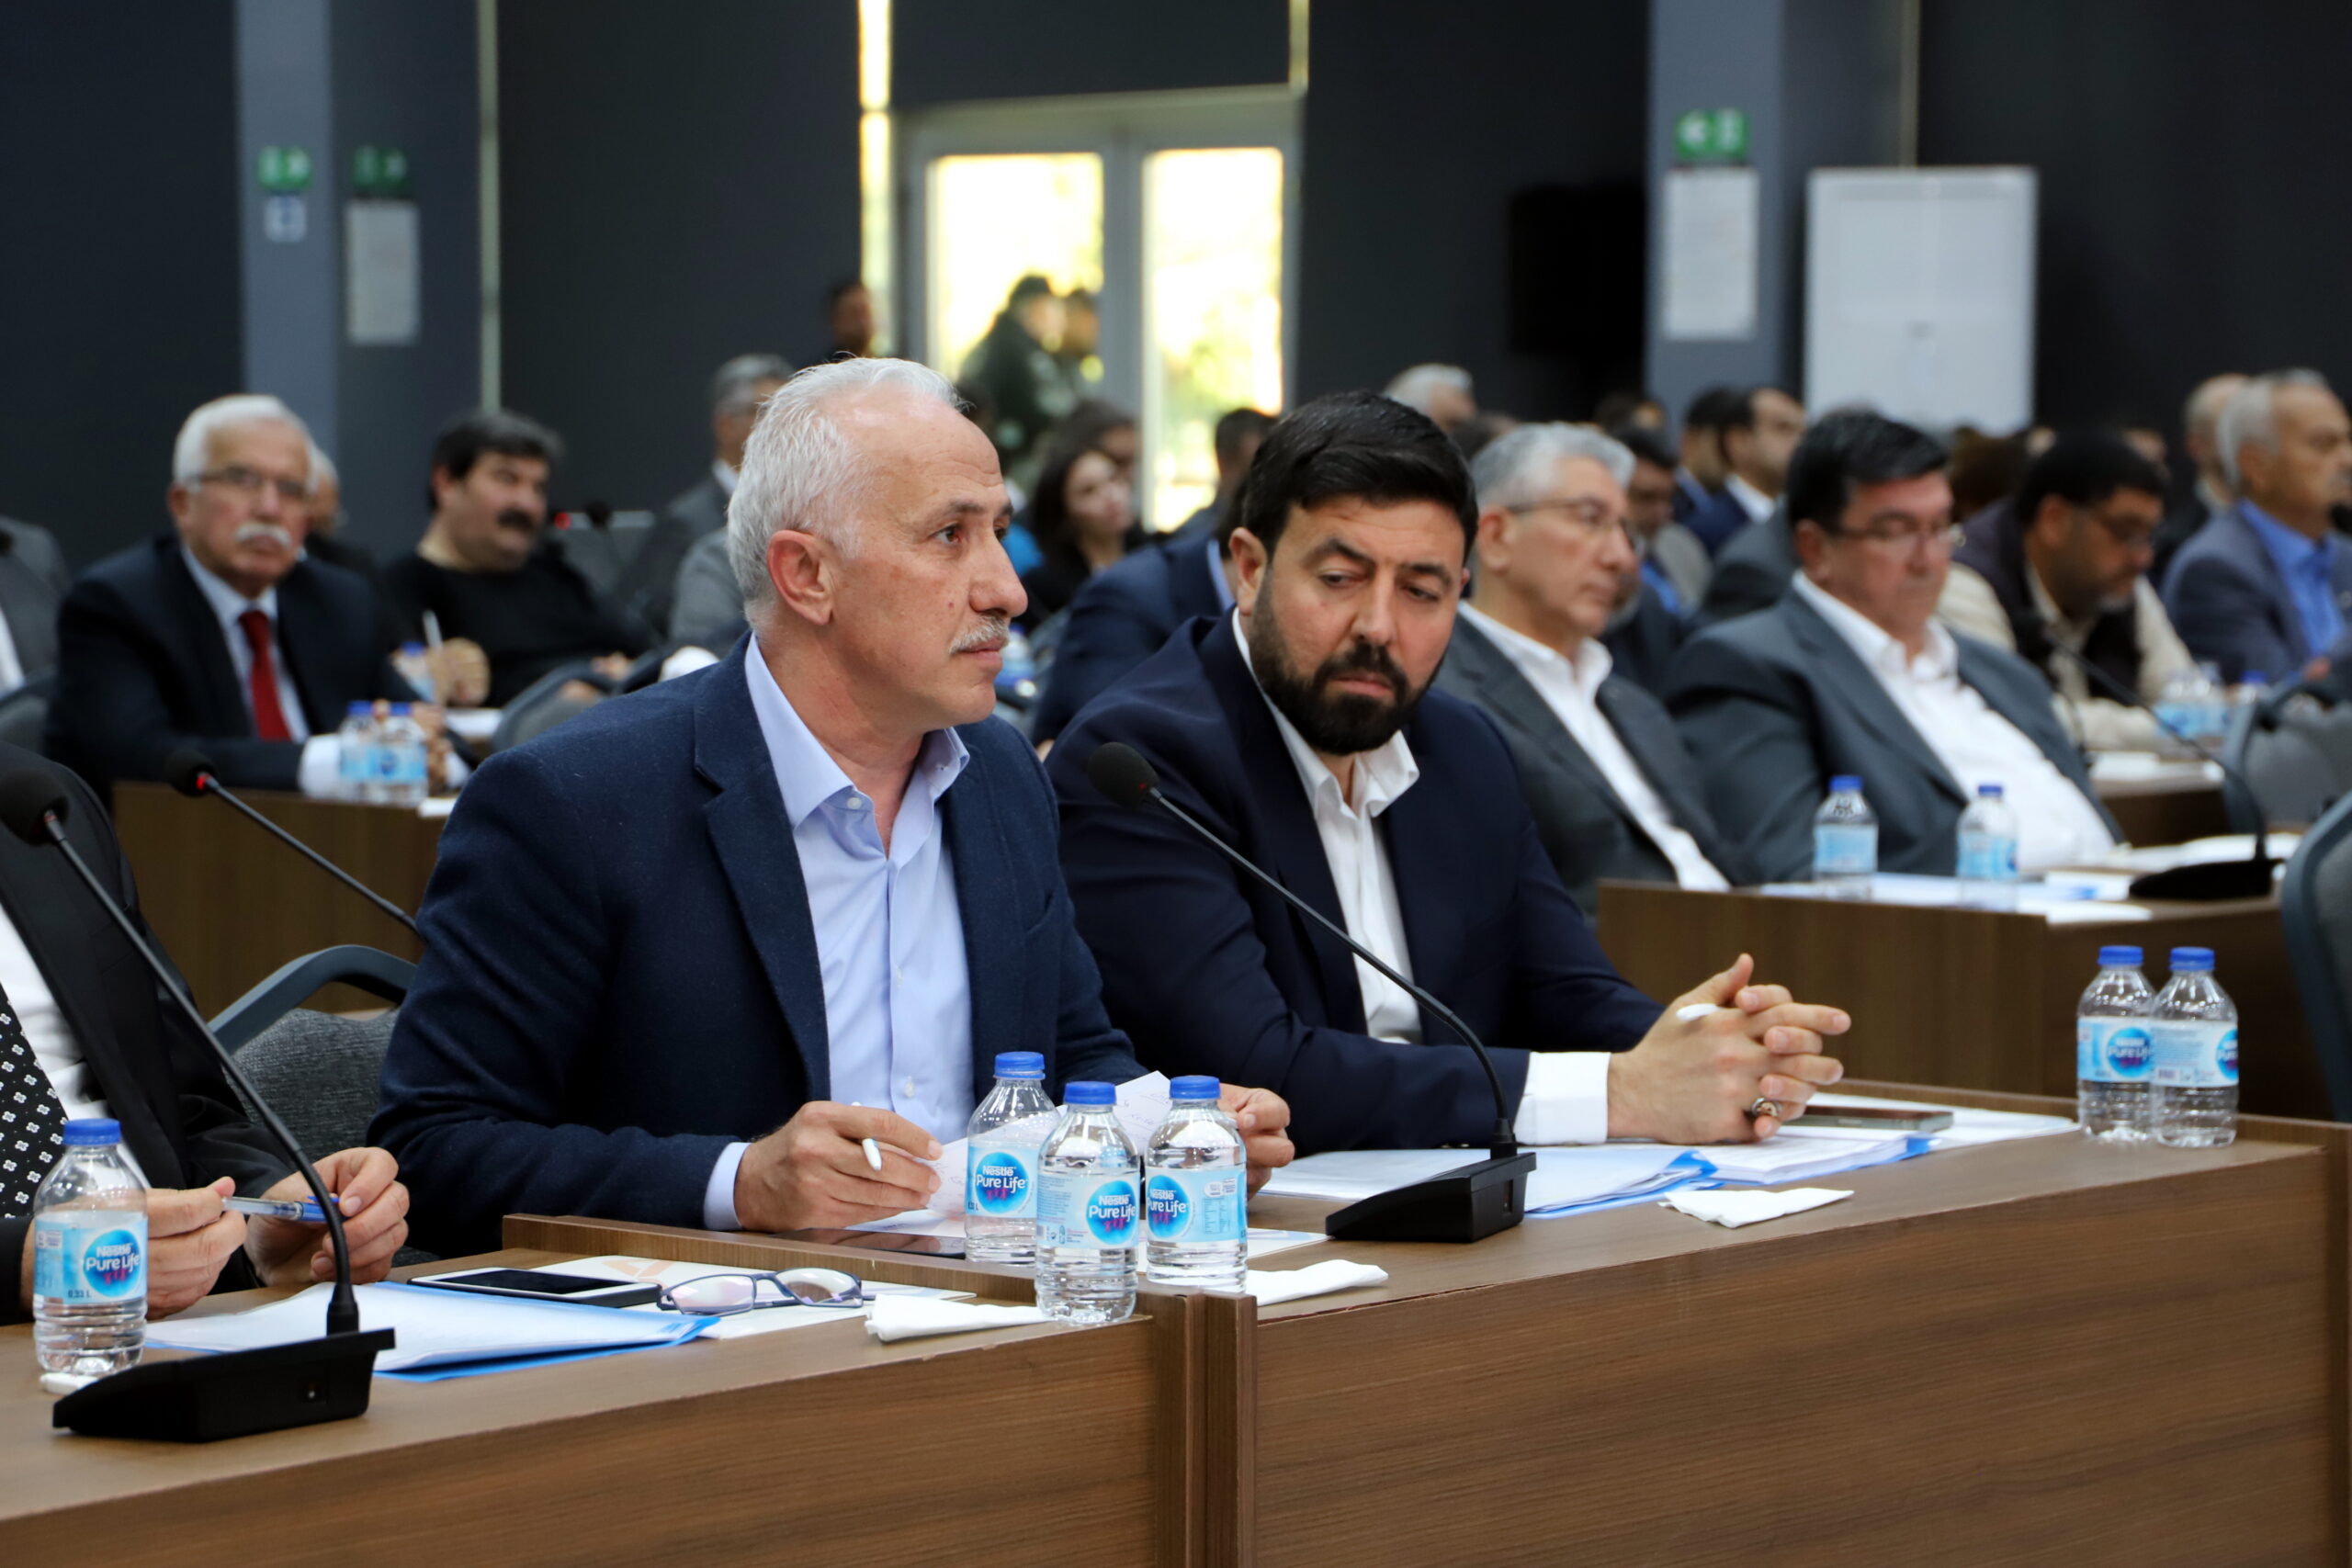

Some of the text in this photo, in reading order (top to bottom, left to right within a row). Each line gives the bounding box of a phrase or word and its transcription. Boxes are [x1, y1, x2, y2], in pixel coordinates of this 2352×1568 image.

[977, 1174, 1001, 1188] Pure
[1003, 1176, 1025, 1193] Life
[1089, 1203, 1136, 1222] Pure Life
[1165, 1201, 1187, 1217] Life
[85, 1253, 141, 1272] Pure Life
